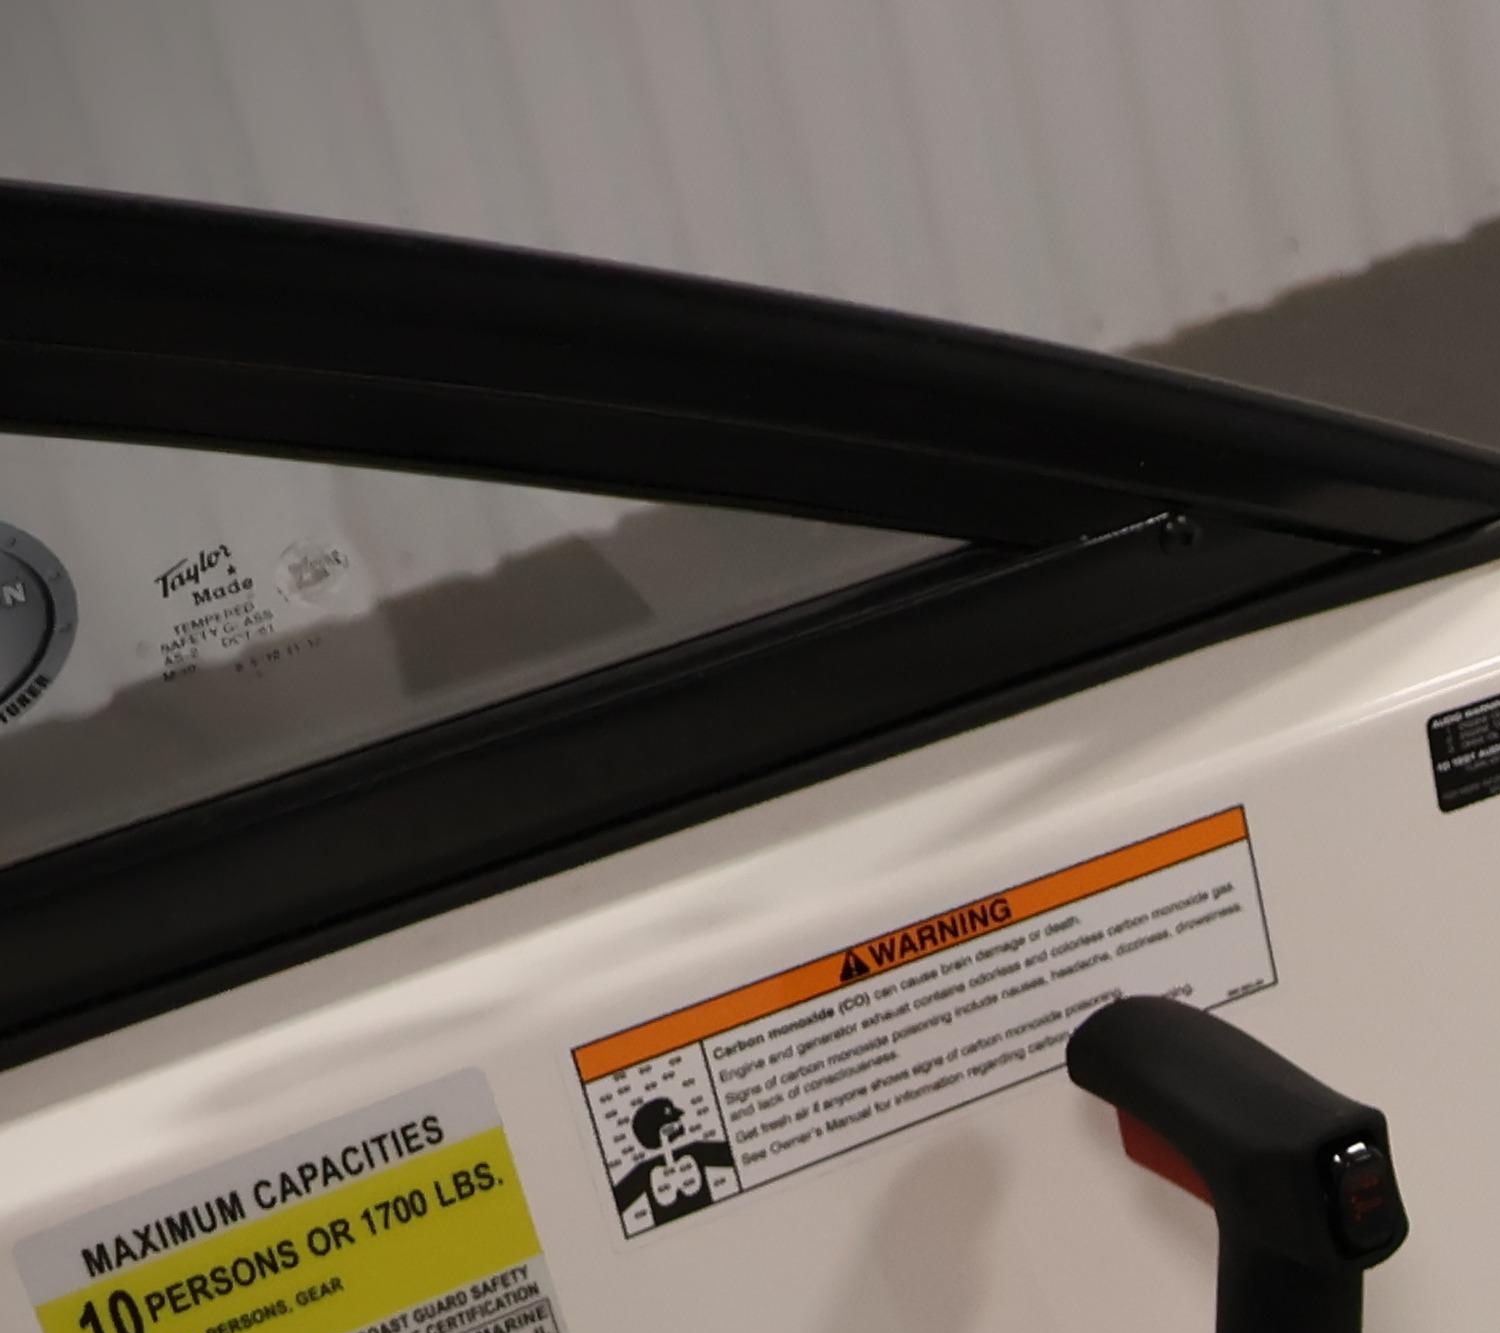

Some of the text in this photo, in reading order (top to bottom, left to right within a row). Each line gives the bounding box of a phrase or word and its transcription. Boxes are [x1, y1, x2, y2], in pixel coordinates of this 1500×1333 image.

[154, 544, 231, 598] Taylor
[191, 578, 253, 606] Made
[867, 897, 1012, 966] WARNING
[712, 1033, 765, 1060] Carbon
[767, 1007, 835, 1040] monoxide
[80, 1115, 444, 1277] MAXIMUM CAPACITIES
[143, 1239, 299, 1323] PERSONS
[306, 1218, 355, 1256] OR
[360, 1188, 427, 1235] 1700
[433, 1161, 503, 1207] LBS.
[295, 1276, 344, 1307] GEAR
[412, 1290, 467, 1324] GUARD
[469, 1264, 527, 1300] SAFETY
